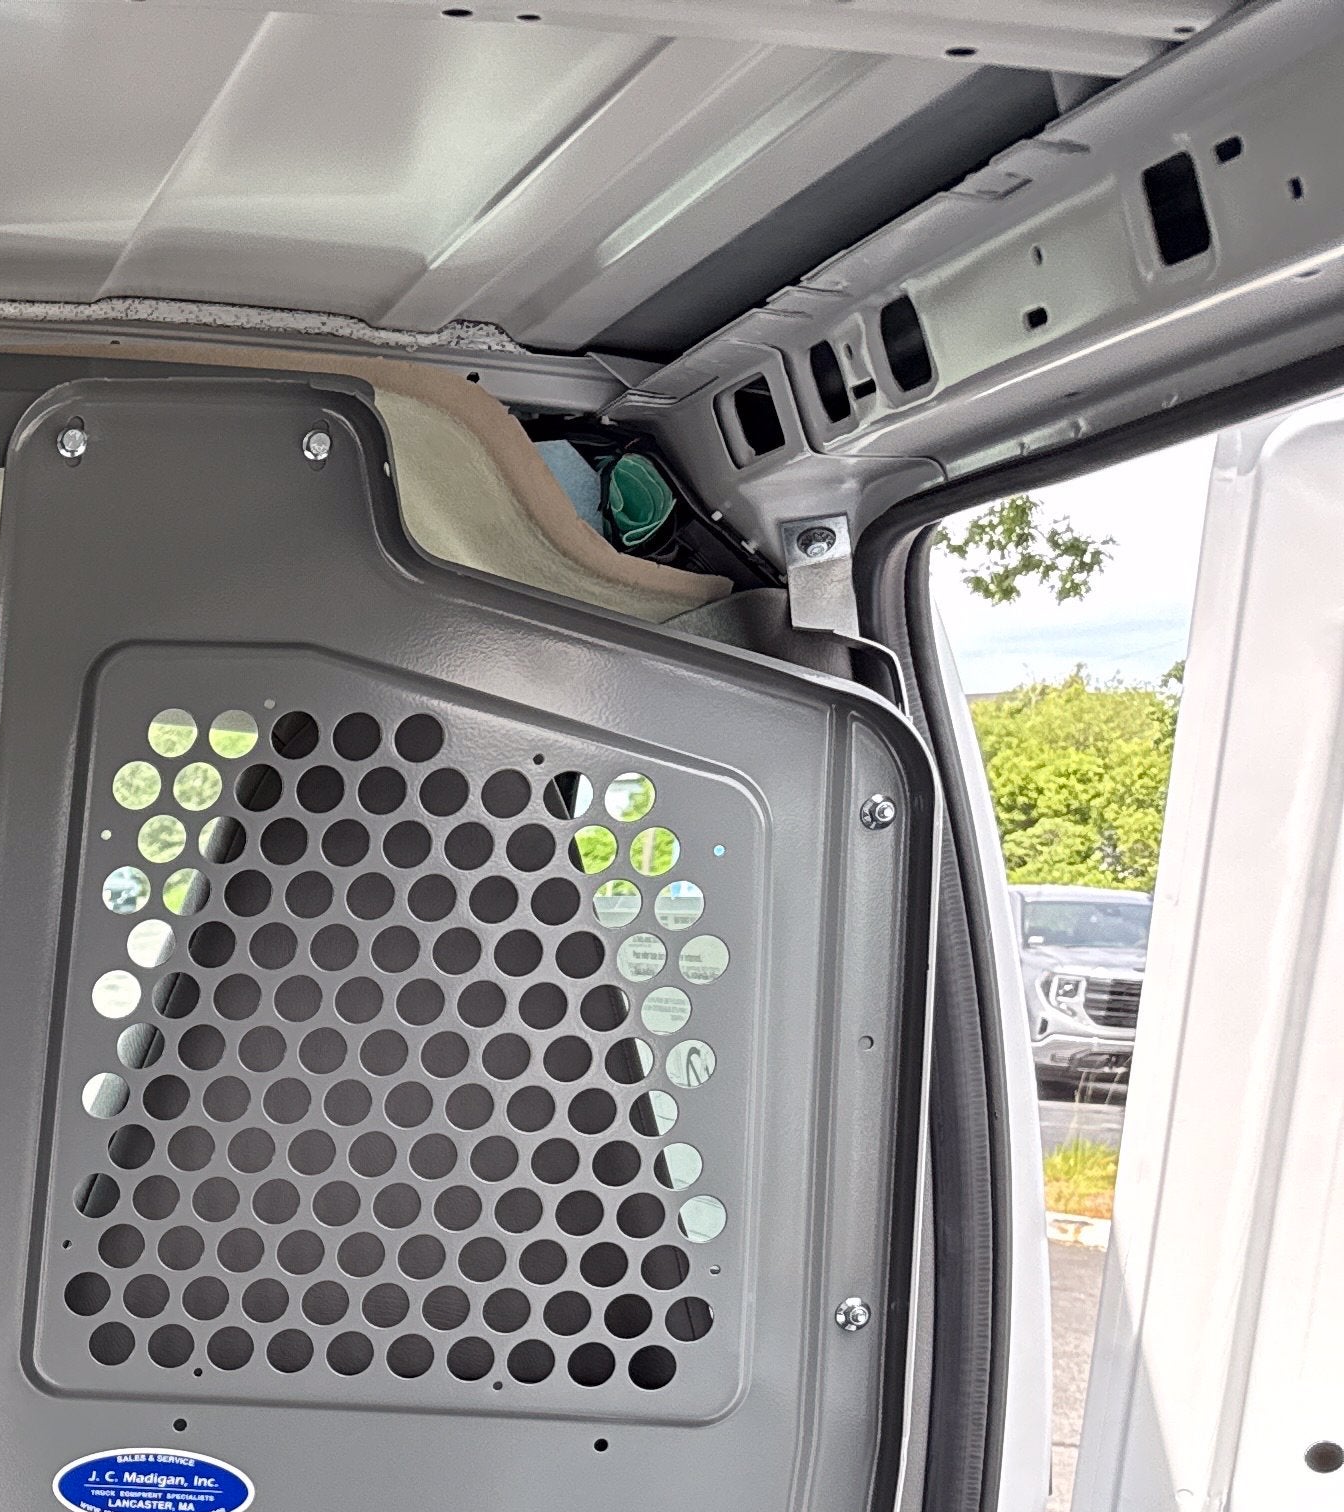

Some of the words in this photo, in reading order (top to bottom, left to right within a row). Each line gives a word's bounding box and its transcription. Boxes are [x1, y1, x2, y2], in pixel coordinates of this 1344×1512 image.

[116, 1454, 146, 1463] SALES
[157, 1454, 195, 1467] SERVICE
[88, 1471, 100, 1482] J.
[105, 1471, 118, 1482] C.
[123, 1472, 188, 1488] Madigan,
[194, 1475, 219, 1487] Inc.
[108, 1499, 175, 1512] LANCASTER,
[178, 1502, 195, 1512] MA
